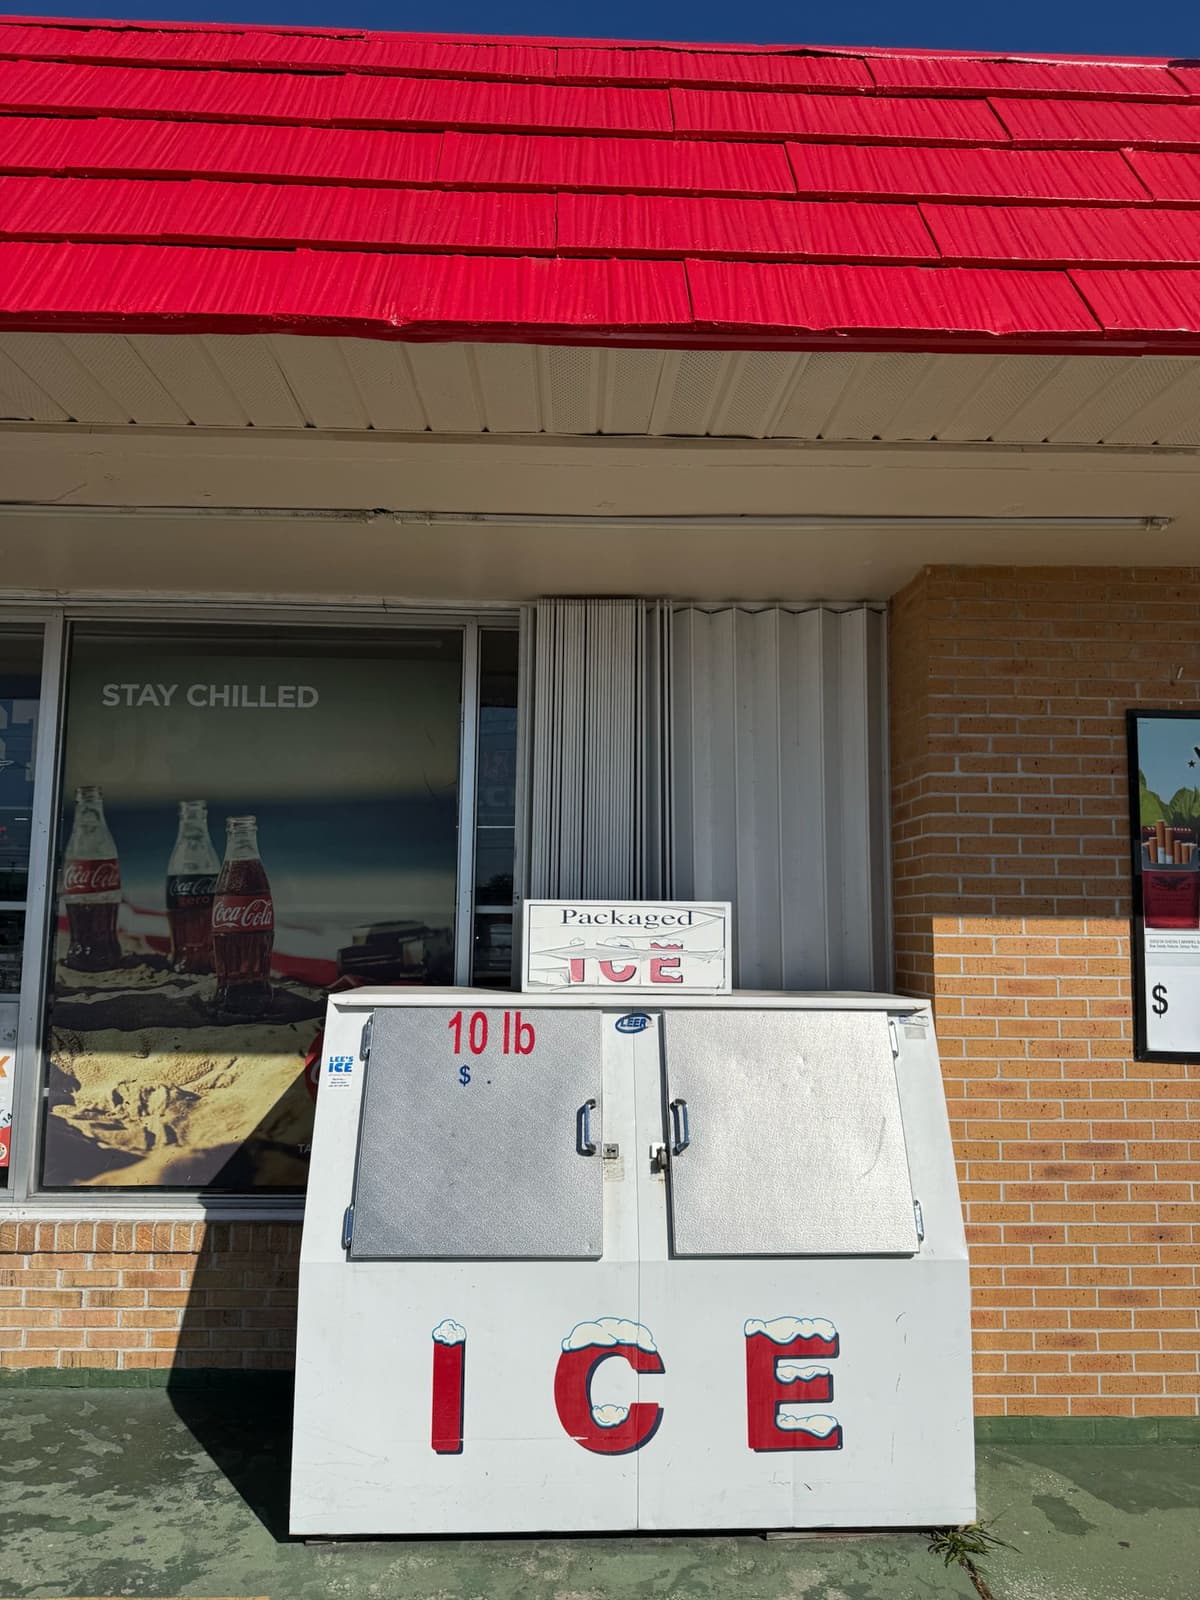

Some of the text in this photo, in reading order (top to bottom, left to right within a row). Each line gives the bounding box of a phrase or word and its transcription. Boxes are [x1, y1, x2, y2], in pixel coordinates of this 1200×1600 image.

[102, 684, 319, 708] STAY CHILLED
[560, 909, 693, 930] Packaged
[569, 937, 684, 984] ICE
[1152, 981, 1169, 1019] $
[448, 1010, 536, 1055] 10 lb
[620, 1018, 647, 1029] LEER
[328, 1062, 353, 1073] ICE
[329, 1055, 354, 1063] LEE'S
[459, 1064, 471, 1087] $
[431, 1316, 843, 1456] ICE
